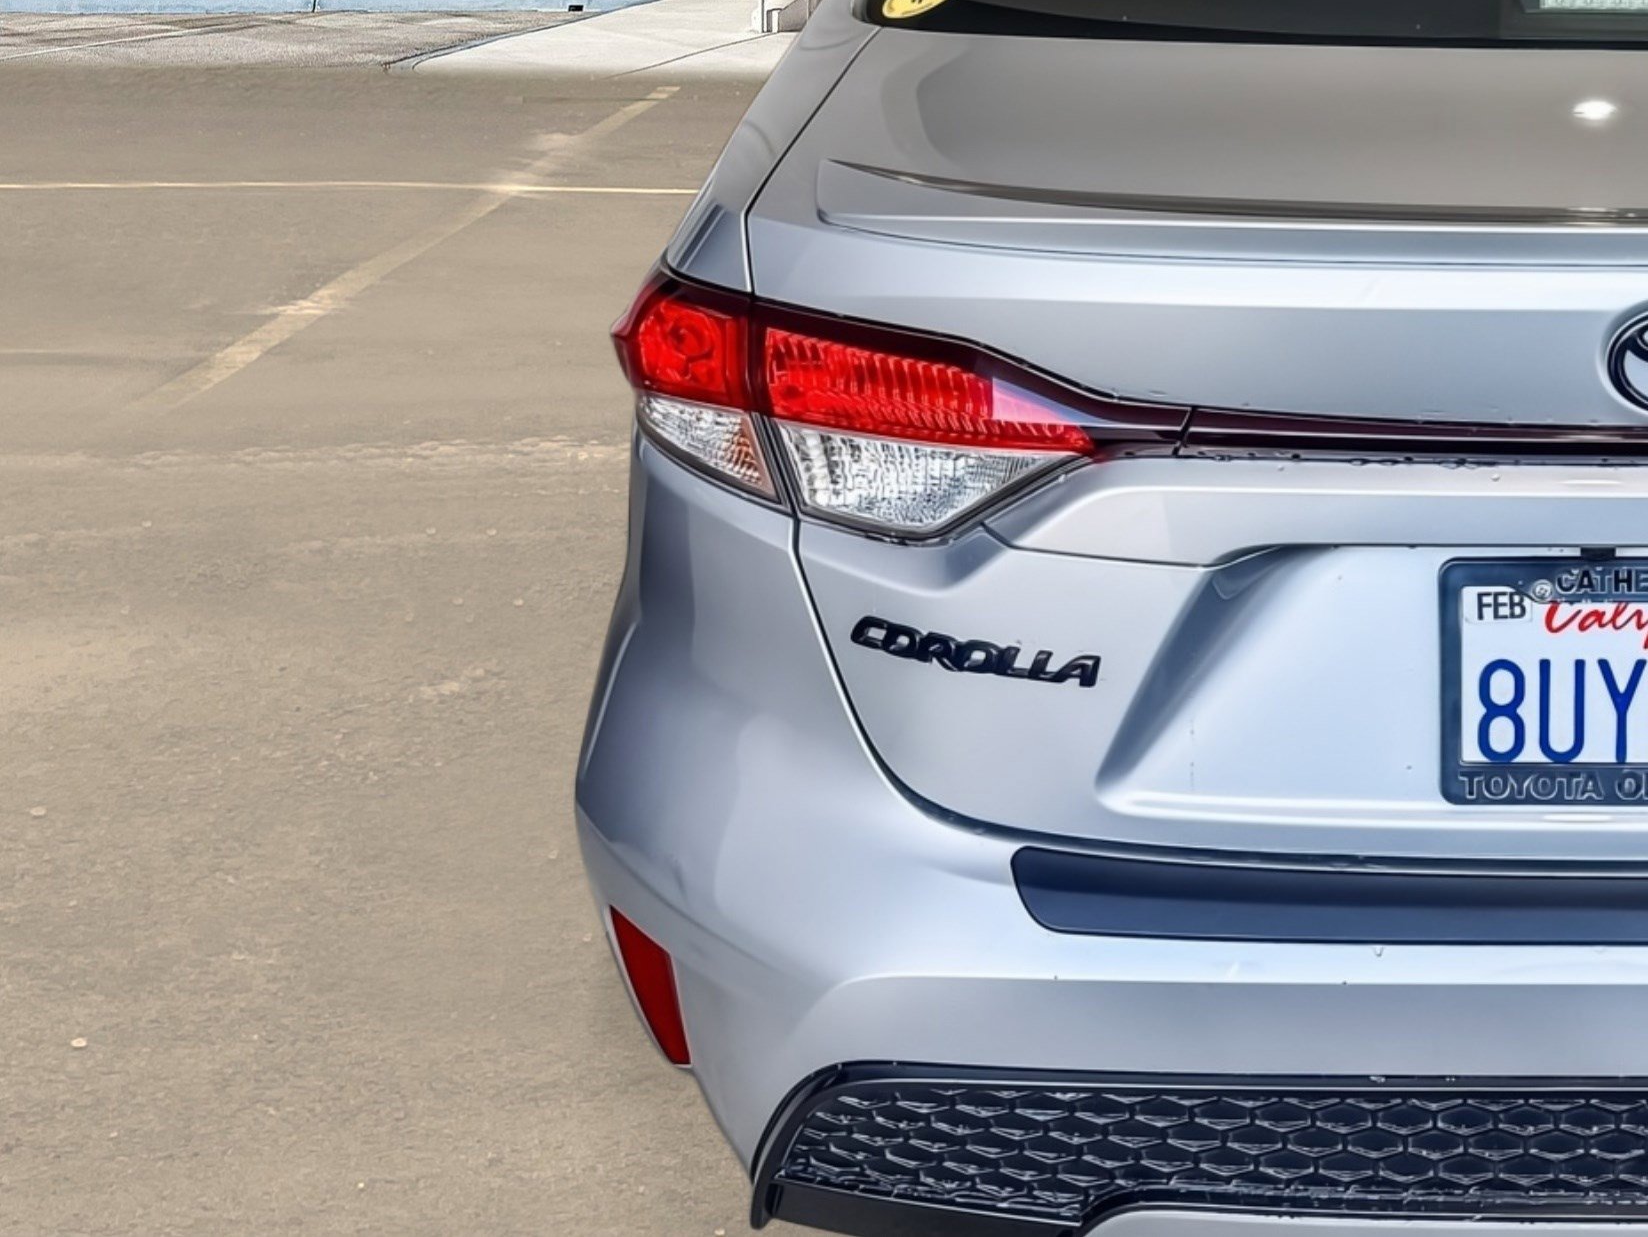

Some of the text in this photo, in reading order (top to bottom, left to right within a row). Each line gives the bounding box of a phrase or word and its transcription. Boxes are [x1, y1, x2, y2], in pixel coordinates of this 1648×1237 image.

[1477, 591, 1527, 621] FEB
[851, 615, 1101, 688] COROLLA
[1458, 770, 1600, 799] TOYOTA
